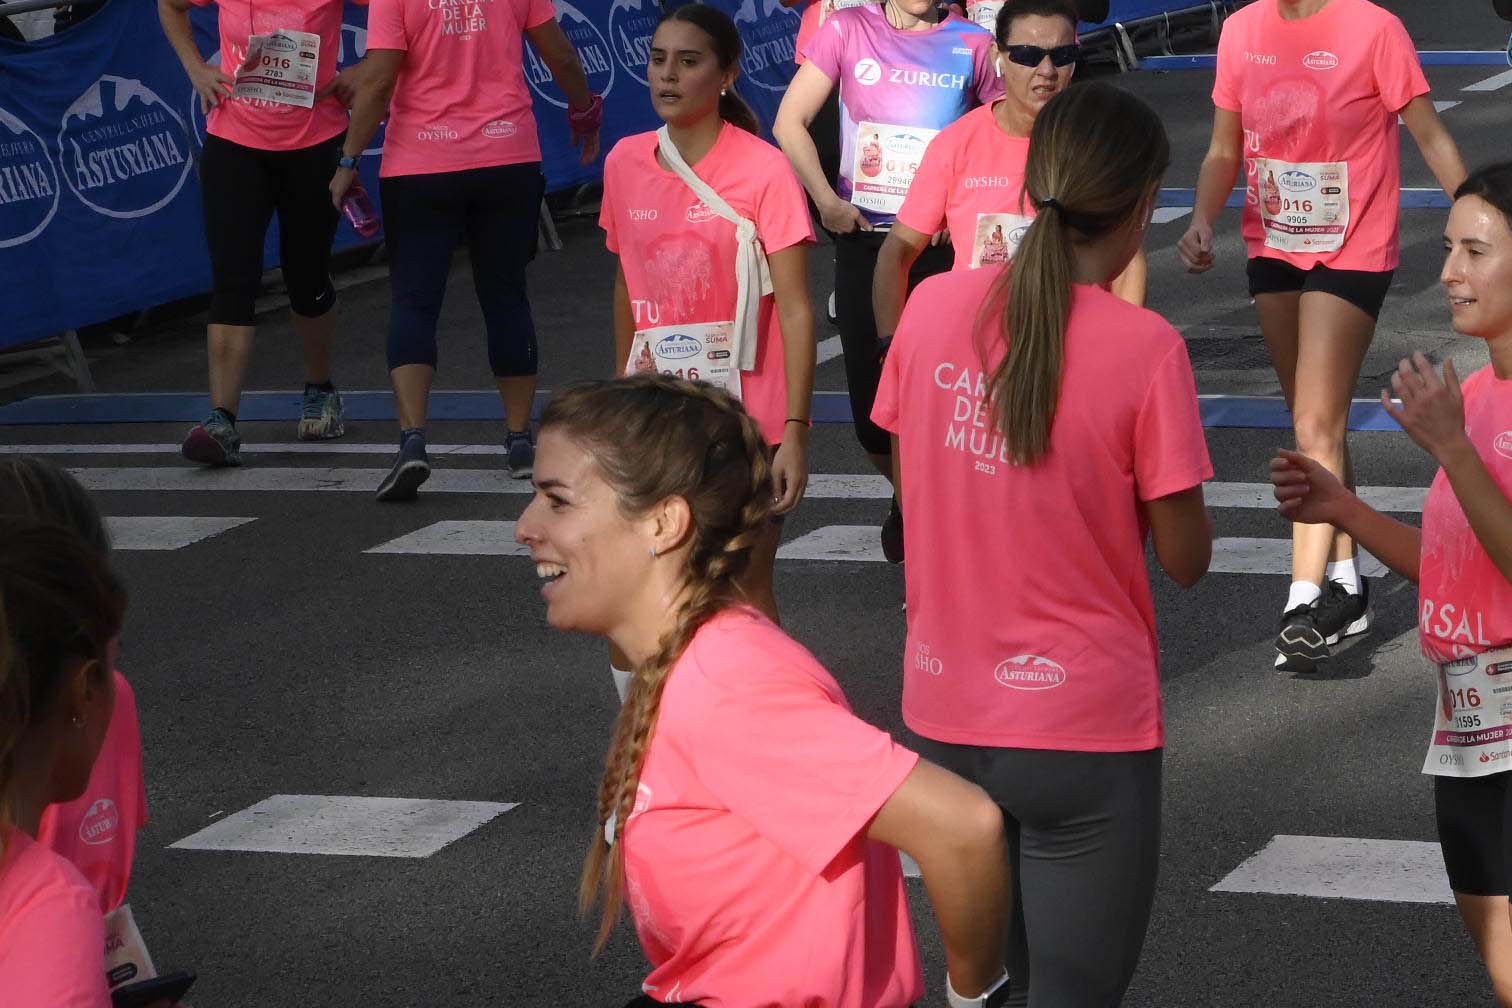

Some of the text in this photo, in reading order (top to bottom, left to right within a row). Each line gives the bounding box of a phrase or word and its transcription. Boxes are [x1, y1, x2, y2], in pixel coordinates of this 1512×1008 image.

[443, 5, 484, 21] DE LA
[442, 18, 486, 36] MUJER
[262, 55, 290, 69] 016
[889, 68, 965, 90] ZURICH
[418, 130, 458, 141] OYSHO
[965, 176, 1009, 189] OYSHO
[1283, 198, 1313, 213] 016
[1286, 215, 1308, 224] 9905
[975, 460, 996, 476] 2023
[999, 664, 1060, 684] ASTURIANA
[1467, 735, 1475, 743] LA
[1476, 730, 1504, 742] MUJER
